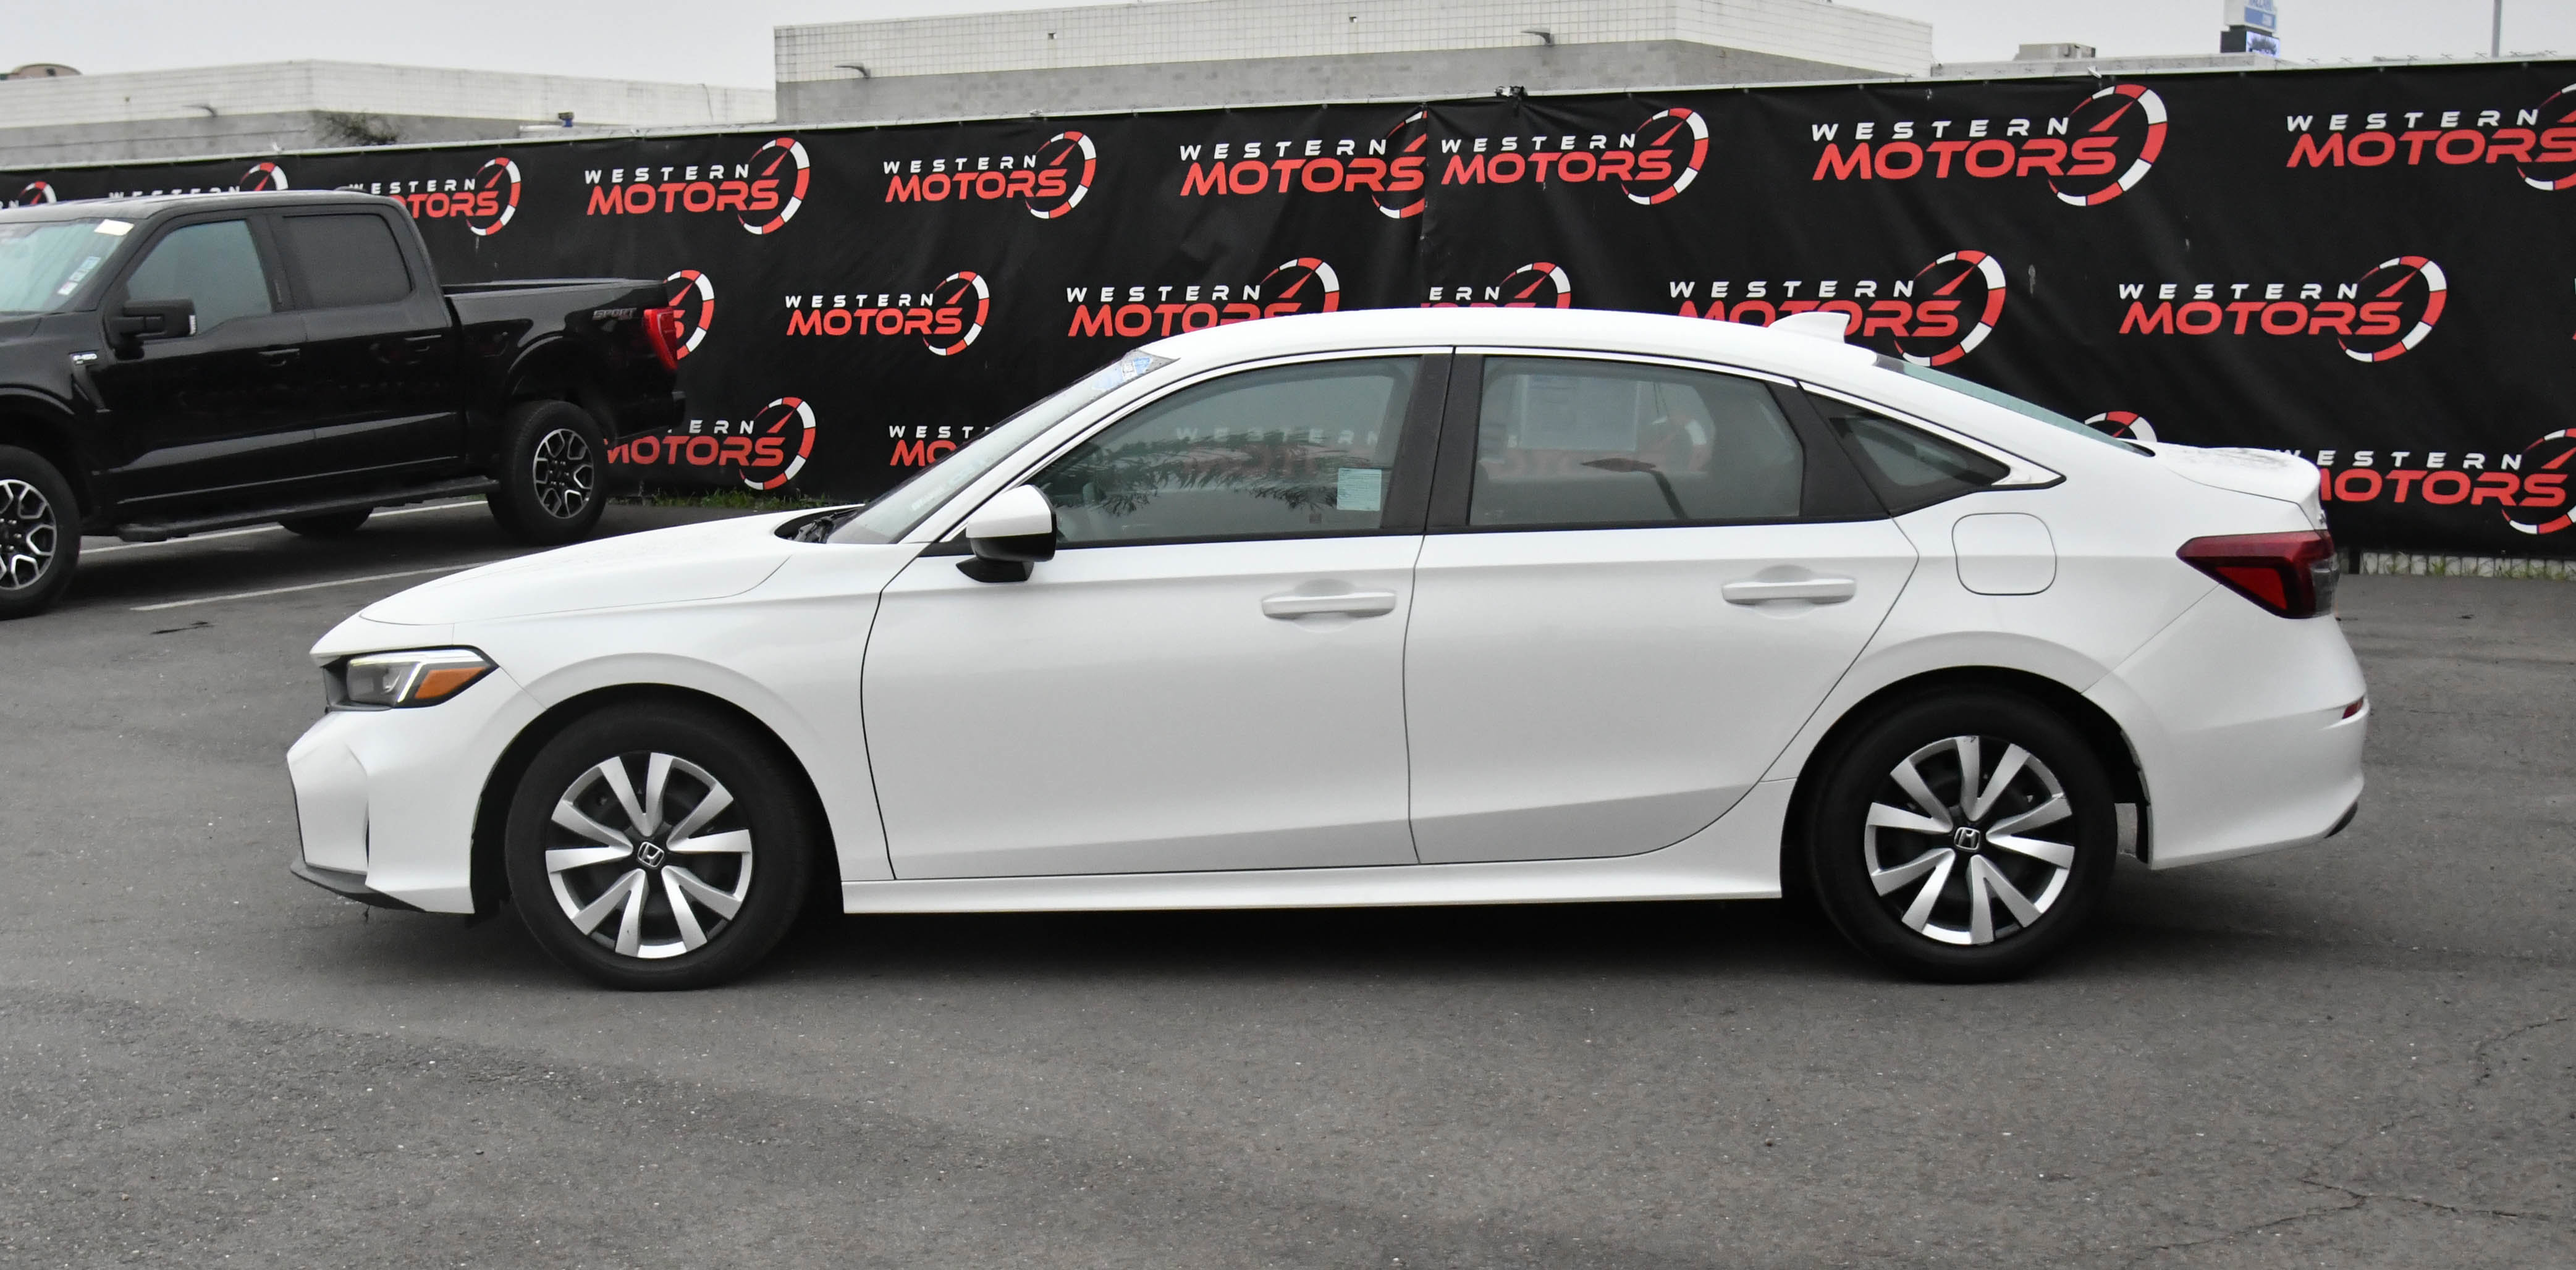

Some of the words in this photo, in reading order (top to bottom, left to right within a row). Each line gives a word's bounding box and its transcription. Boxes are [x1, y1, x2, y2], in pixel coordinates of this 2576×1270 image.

[1812, 117, 2069, 141] WESTERN
[2287, 109, 2538, 132] WESTERN
[1180, 139, 1387, 161] WESTERN
[1441, 133, 1636, 154] WESTERN
[2286, 127, 2576, 167] MOTORS
[883, 154, 1036, 174] WESTERN
[1442, 149, 1673, 185] MOTORS
[1812, 136, 2119, 180] MOTORS
[585, 164, 749, 184] WESTERN
[885, 168, 1068, 203] MOTORS
[1180, 156, 1426, 196] MOTORS
[391, 190, 499, 219] TORS
[587, 179, 779, 215] MOTORS
[785, 293, 934, 308] WESTERN
[1066, 285, 1261, 303] WESTERN
[1670, 280, 1914, 298] WESTERN
[2119, 283, 2358, 300] WESTERN
[592, 308, 637, 320] SPORT
[786, 307, 963, 336] MOTORS
[2119, 301, 2403, 335] MOTORS
[889, 426, 990, 439] WEST
[2320, 468, 2567, 507] OTORS
